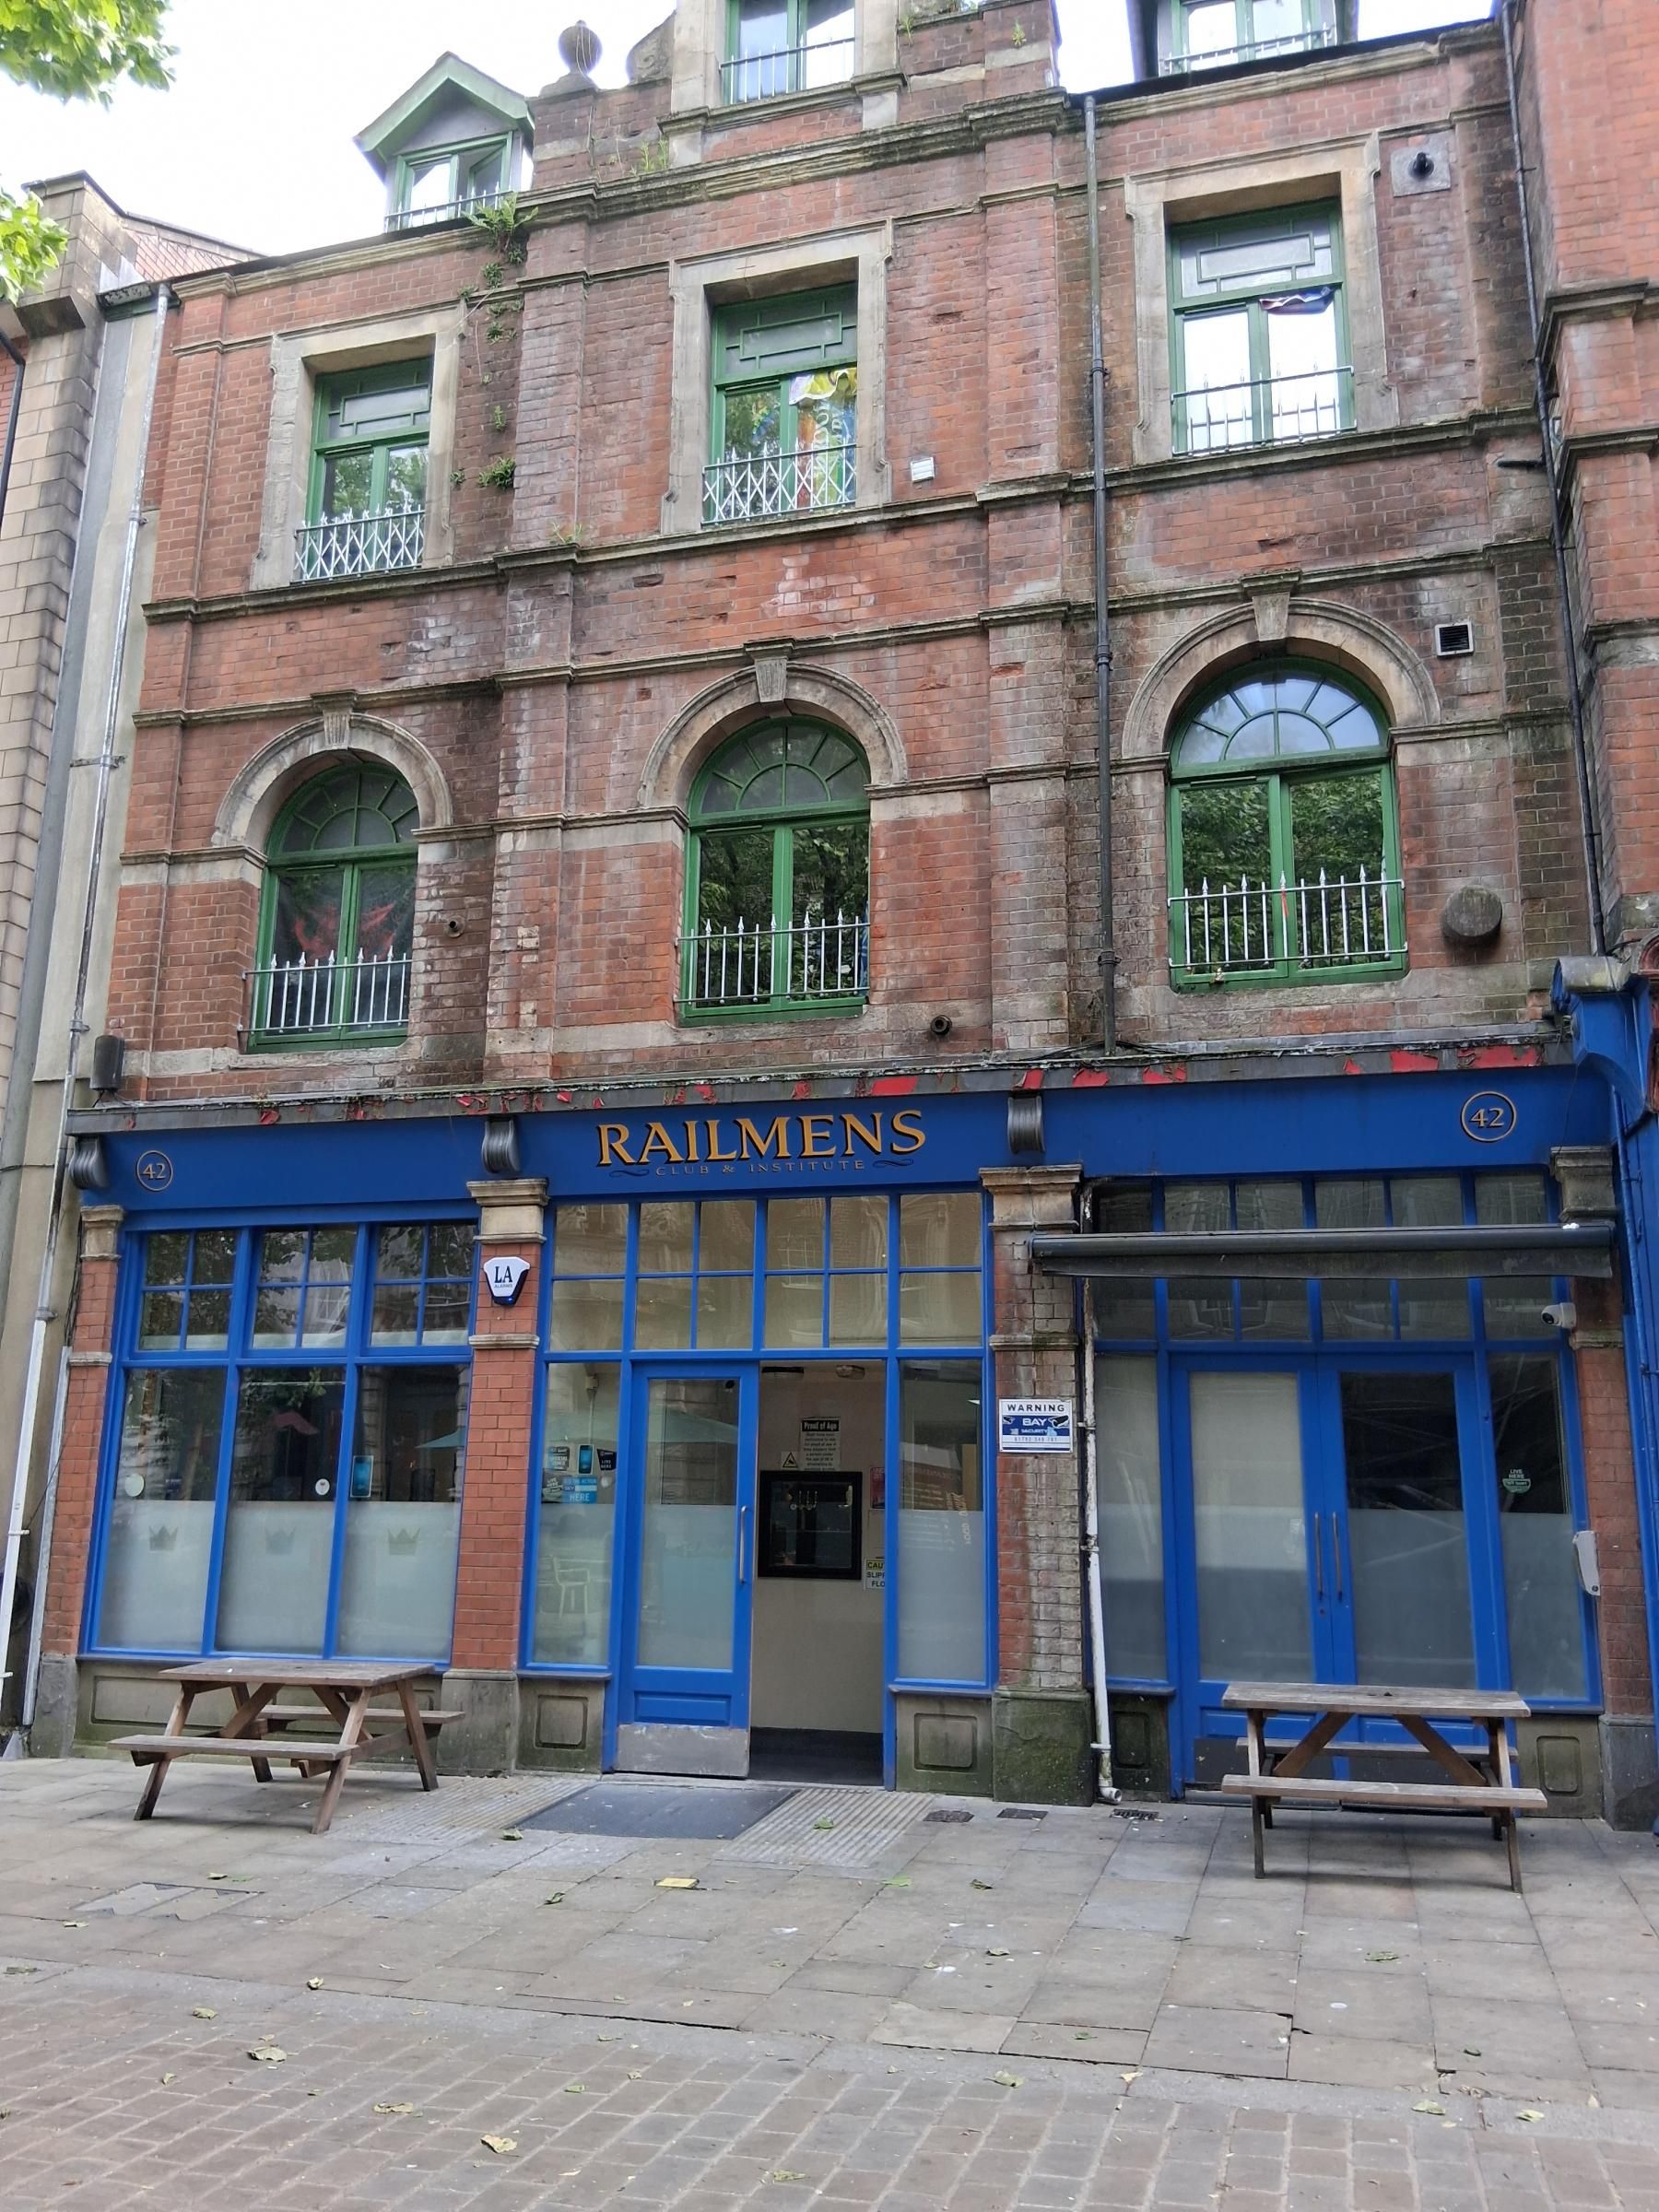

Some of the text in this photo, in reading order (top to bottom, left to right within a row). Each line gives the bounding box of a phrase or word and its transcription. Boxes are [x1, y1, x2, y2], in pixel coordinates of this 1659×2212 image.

[1470, 1108, 1505, 1127] 42
[596, 1109, 926, 1167] RAILMENS
[142, 1162, 166, 1180] 42
[655, 1159, 865, 1176] CLUB & INSTITUTE
[494, 1265, 513, 1284] LA
[1007, 1404, 1065, 1412] WARNING
[1022, 1418, 1047, 1427] BAY
[569, 1493, 590, 1501] HERE
